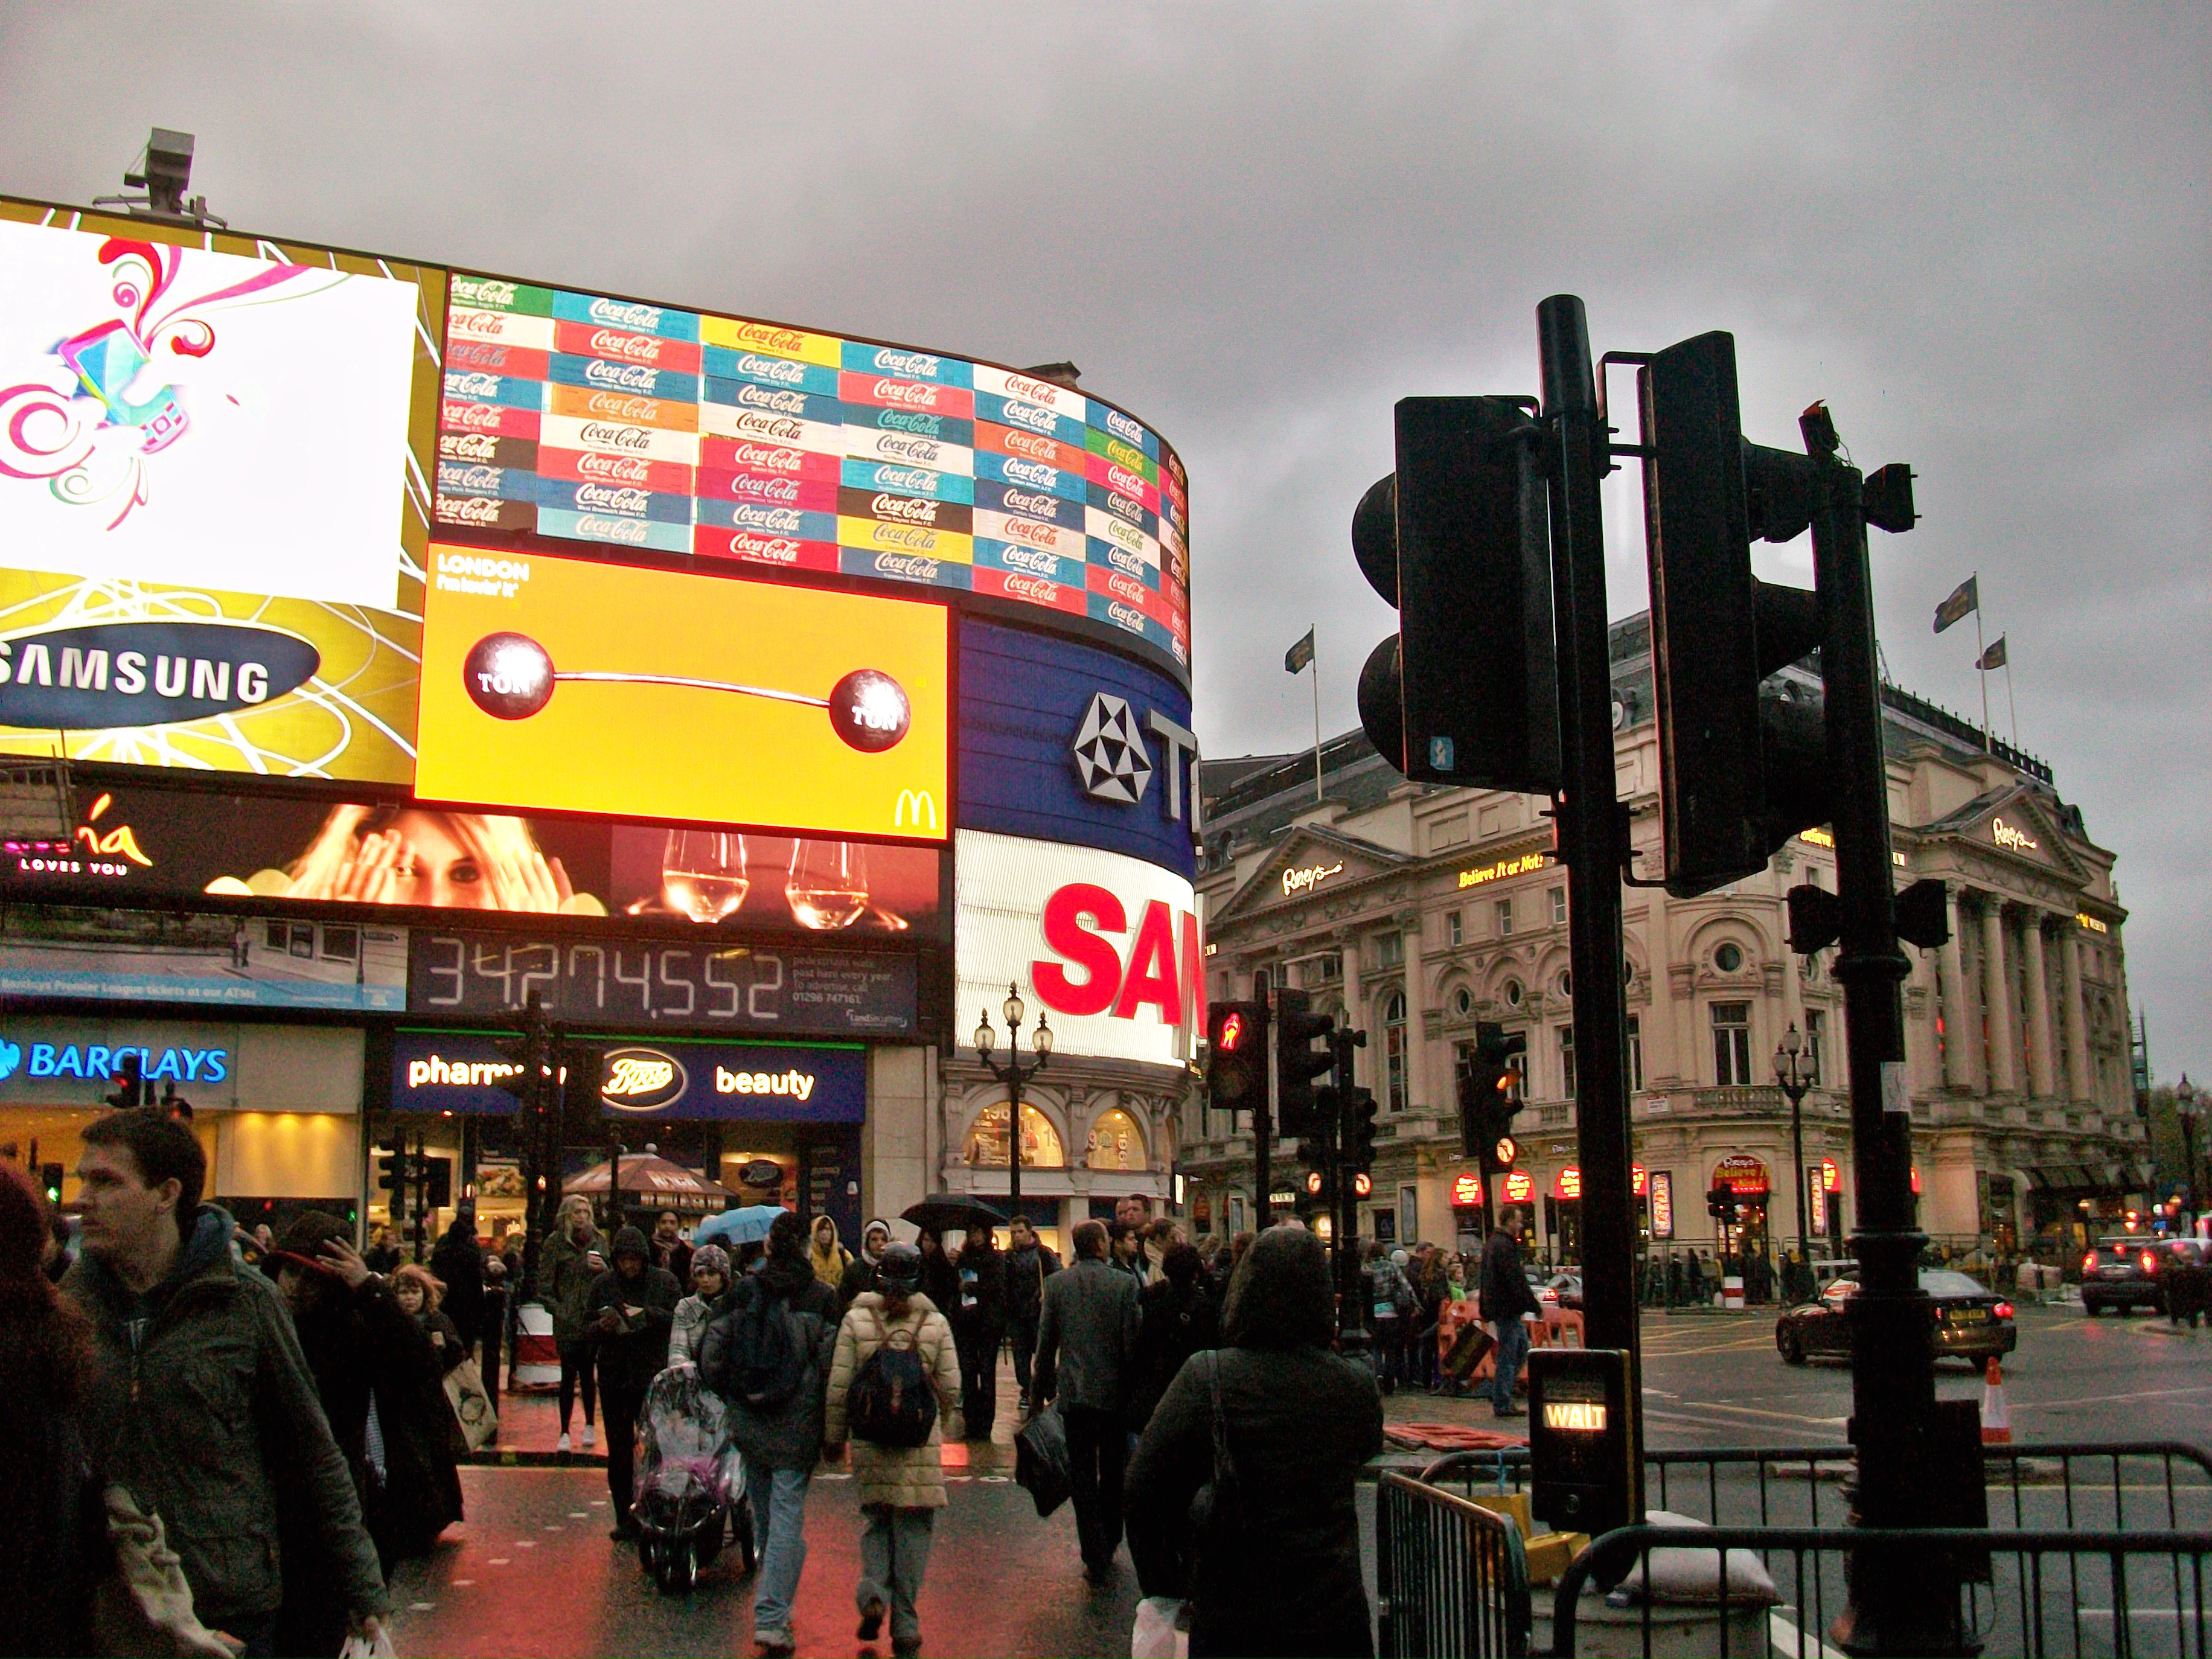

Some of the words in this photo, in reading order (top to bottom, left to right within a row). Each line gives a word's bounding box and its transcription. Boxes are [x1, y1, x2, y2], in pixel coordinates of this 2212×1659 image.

[438, 553, 529, 581] LONDON
[478, 673, 529, 694] TON
[852, 706, 898, 730] TON
[19, 857, 81, 874] LOVES
[88, 862, 127, 877] YOU
[1459, 868, 1495, 888] Believe
[1496, 862, 1506, 878] It
[1507, 861, 1520, 875] or
[1520, 853, 1544, 872] Not!
[408, 1055, 567, 1088] pharm
[601, 1059, 673, 1096] Boots
[715, 1066, 816, 1101] beauty
[1546, 1404, 1606, 1429] WAIT
